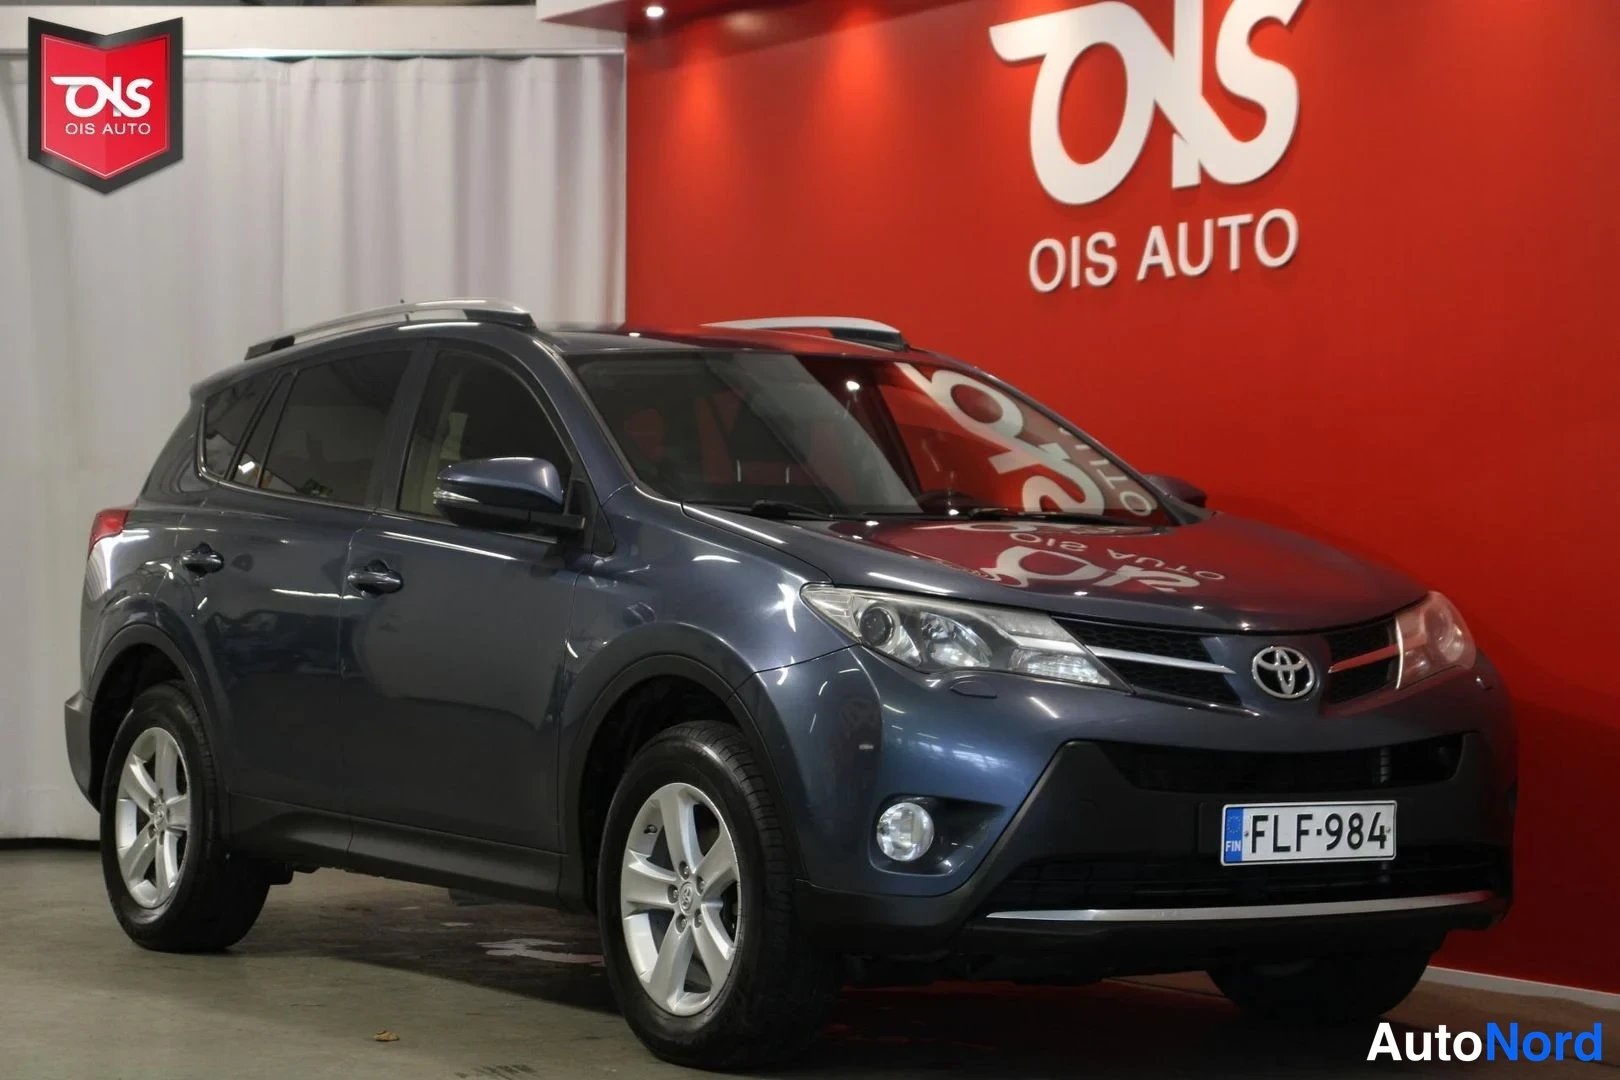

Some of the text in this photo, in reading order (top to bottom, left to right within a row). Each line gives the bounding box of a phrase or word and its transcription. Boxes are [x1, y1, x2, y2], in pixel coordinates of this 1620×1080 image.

[1029, 208, 1299, 293] OIS AUTO
[1225, 840, 1241, 852] FIN
[1251, 811, 1388, 854] FLF-984
